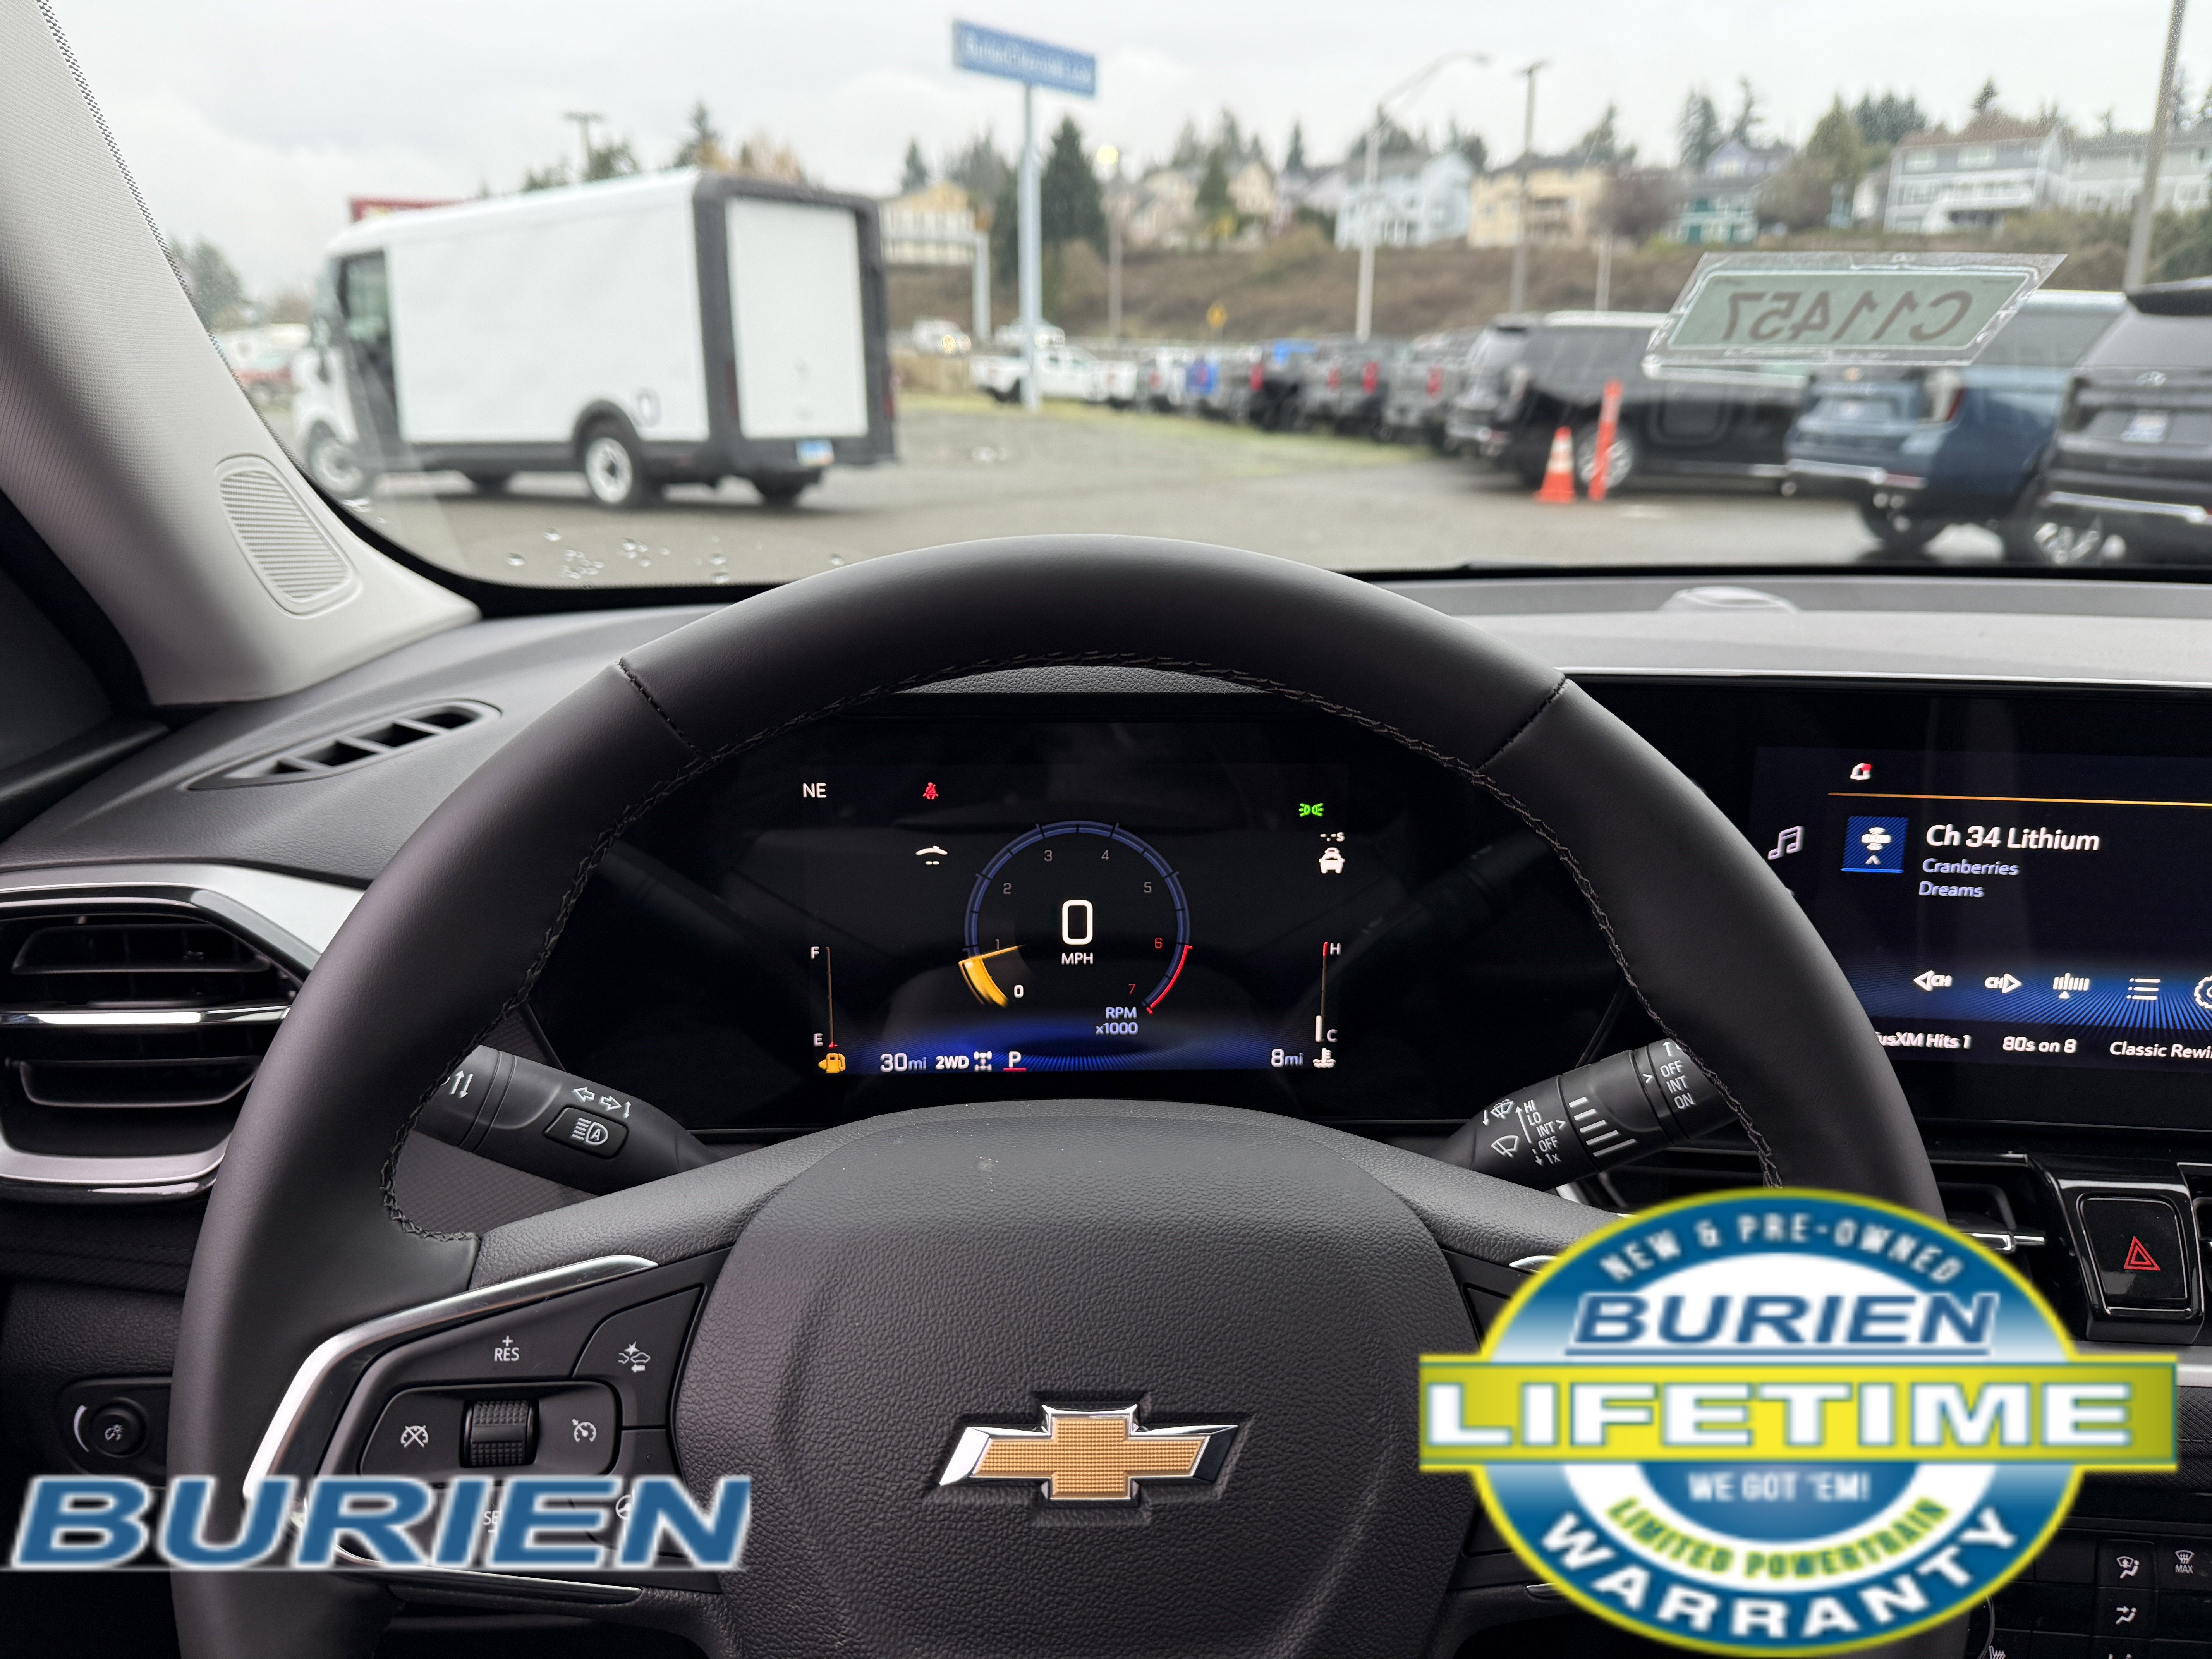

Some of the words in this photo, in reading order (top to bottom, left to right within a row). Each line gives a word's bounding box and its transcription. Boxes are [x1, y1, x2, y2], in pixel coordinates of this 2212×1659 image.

[802, 783, 827, 798] NE
[1926, 824, 1961, 847] Ch
[1966, 825, 2002, 847] 34
[2007, 827, 2100, 851] Lithium
[1044, 850, 1053, 862] 3
[1101, 850, 1109, 860] 4
[1922, 858, 2020, 876] Cranberries
[1003, 883, 1012, 895] 2
[1144, 882, 1152, 893] 5
[1918, 881, 1985, 898] Dreams
[1062, 900, 1093, 945] 0
[995, 939, 1000, 950] 1
[1154, 937, 1163, 949] 6
[1330, 943, 1341, 956] H
[810, 946, 820, 959] F
[1061, 952, 1093, 965] MPH
[1014, 985, 1024, 998] 0
[1128, 984, 1136, 994] 7
[1106, 1006, 1137, 1019] RPM
[1095, 1022, 1138, 1035] x1000
[814, 1033, 823, 1046] E
[1327, 1029, 1338, 1043] C
[1926, 1033, 1960, 1049] Hits
[1963, 1035, 1972, 1049] 1
[2002, 1036, 2035, 1052] 80s
[2038, 1041, 2060, 1053] on
[2064, 1039, 2077, 1053] 8
[2110, 1041, 2167, 1057] Classic
[2171, 1044, 2212, 1059] Rewi
[935, 1055, 969, 1069] 2WD
[1009, 1051, 1021, 1068] P
[1660, 1060, 1682, 1077] OFF
[1666, 1075, 1688, 1094] INT
[1523, 1099, 1537, 1113] HI
[1674, 1092, 1694, 1109] ON
[1527, 1111, 1542, 1126] LO
[1536, 1121, 1555, 1137] INT
[1538, 1135, 1558, 1152] OFF
[494, 1347, 519, 1362] RES
[483, 1510, 500, 1525] SE
[2175, 1564, 2193, 1574] MAX
